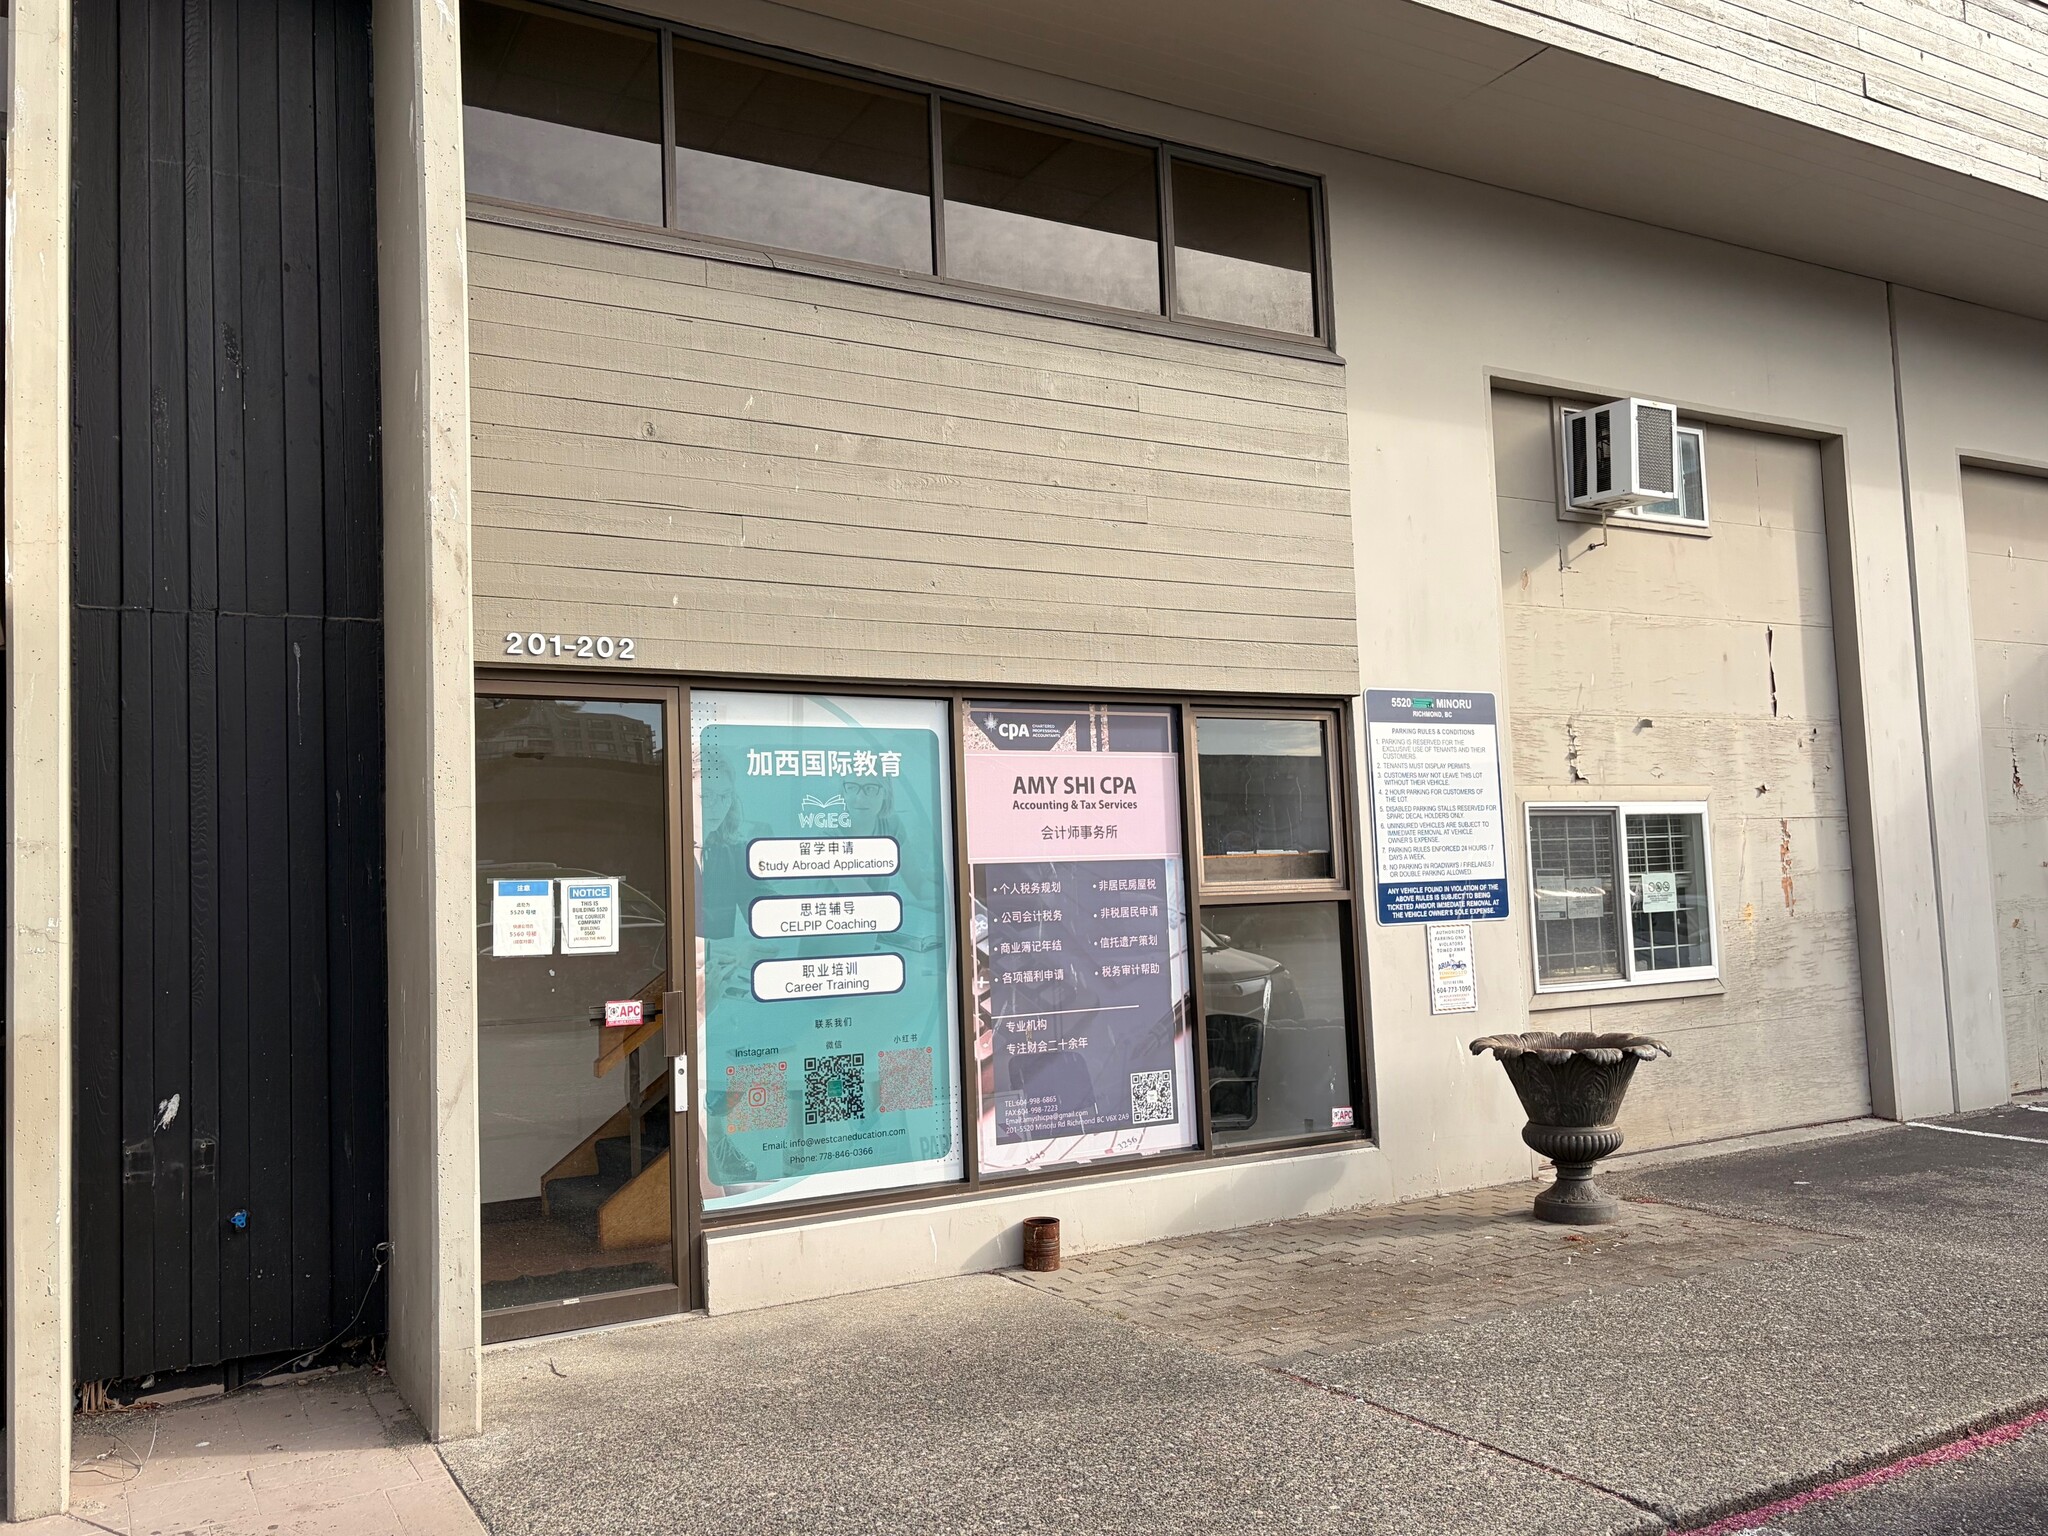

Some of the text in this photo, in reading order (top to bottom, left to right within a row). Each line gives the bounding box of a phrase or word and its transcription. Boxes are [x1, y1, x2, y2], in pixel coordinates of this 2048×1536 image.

[505, 632, 635, 659] 201-202
[1436, 699, 1472, 709] MINORU
[747, 748, 902, 777] 加西国际教育
[1013, 776, 1136, 794] AMY SHI CPA
[1012, 799, 1137, 812] Accounting & Tax Services
[798, 813, 852, 828] WGEG
[1040, 825, 1118, 840] 会计师事务所
[799, 841, 854, 856] 留学申请
[758, 858, 894, 872] Study Abroad Applications
[1000, 881, 1061, 895] 个人税务规划
[1099, 879, 1156, 891] 非居民房屋税
[572, 889, 607, 897] NOTICE
[800, 902, 855, 917] 思培辅导
[1002, 910, 1063, 923] 公司会计税务
[1100, 906, 1158, 919] 非税居民申请
[1428, 909, 1453, 917] OWNER'S
[780, 919, 877, 932] CELPIP Coaching
[1000, 940, 1062, 954] 商业簿记年结
[1100, 935, 1158, 948] 信托遗产策划
[802, 962, 858, 978] 职业培训
[1002, 969, 1064, 984] 各项福利申请
[1102, 964, 1160, 978] 税务审计帮助
[785, 979, 870, 993] Career Training
[1436, 986, 1471, 994] 604-773-1090
[620, 1005, 640, 1017] APC
[814, 1018, 852, 1028] 联系我们
[1006, 1019, 1047, 1032] 专业机构
[825, 1040, 843, 1050] 微信
[893, 1034, 918, 1044] 小红书
[1006, 1037, 1088, 1055] 专注财会二十余年
[735, 1047, 779, 1058] Instagram
[1340, 1111, 1353, 1119] APC
[1006, 1125, 1034, 1134] 201-5520
[1035, 1122, 1057, 1130] Minoru
[1067, 1117, 1096, 1126] Richmond
[762, 1127, 906, 1151] Email: info@westcaneducation.com
[789, 1147, 873, 1164] Phone: 778-846-0366
